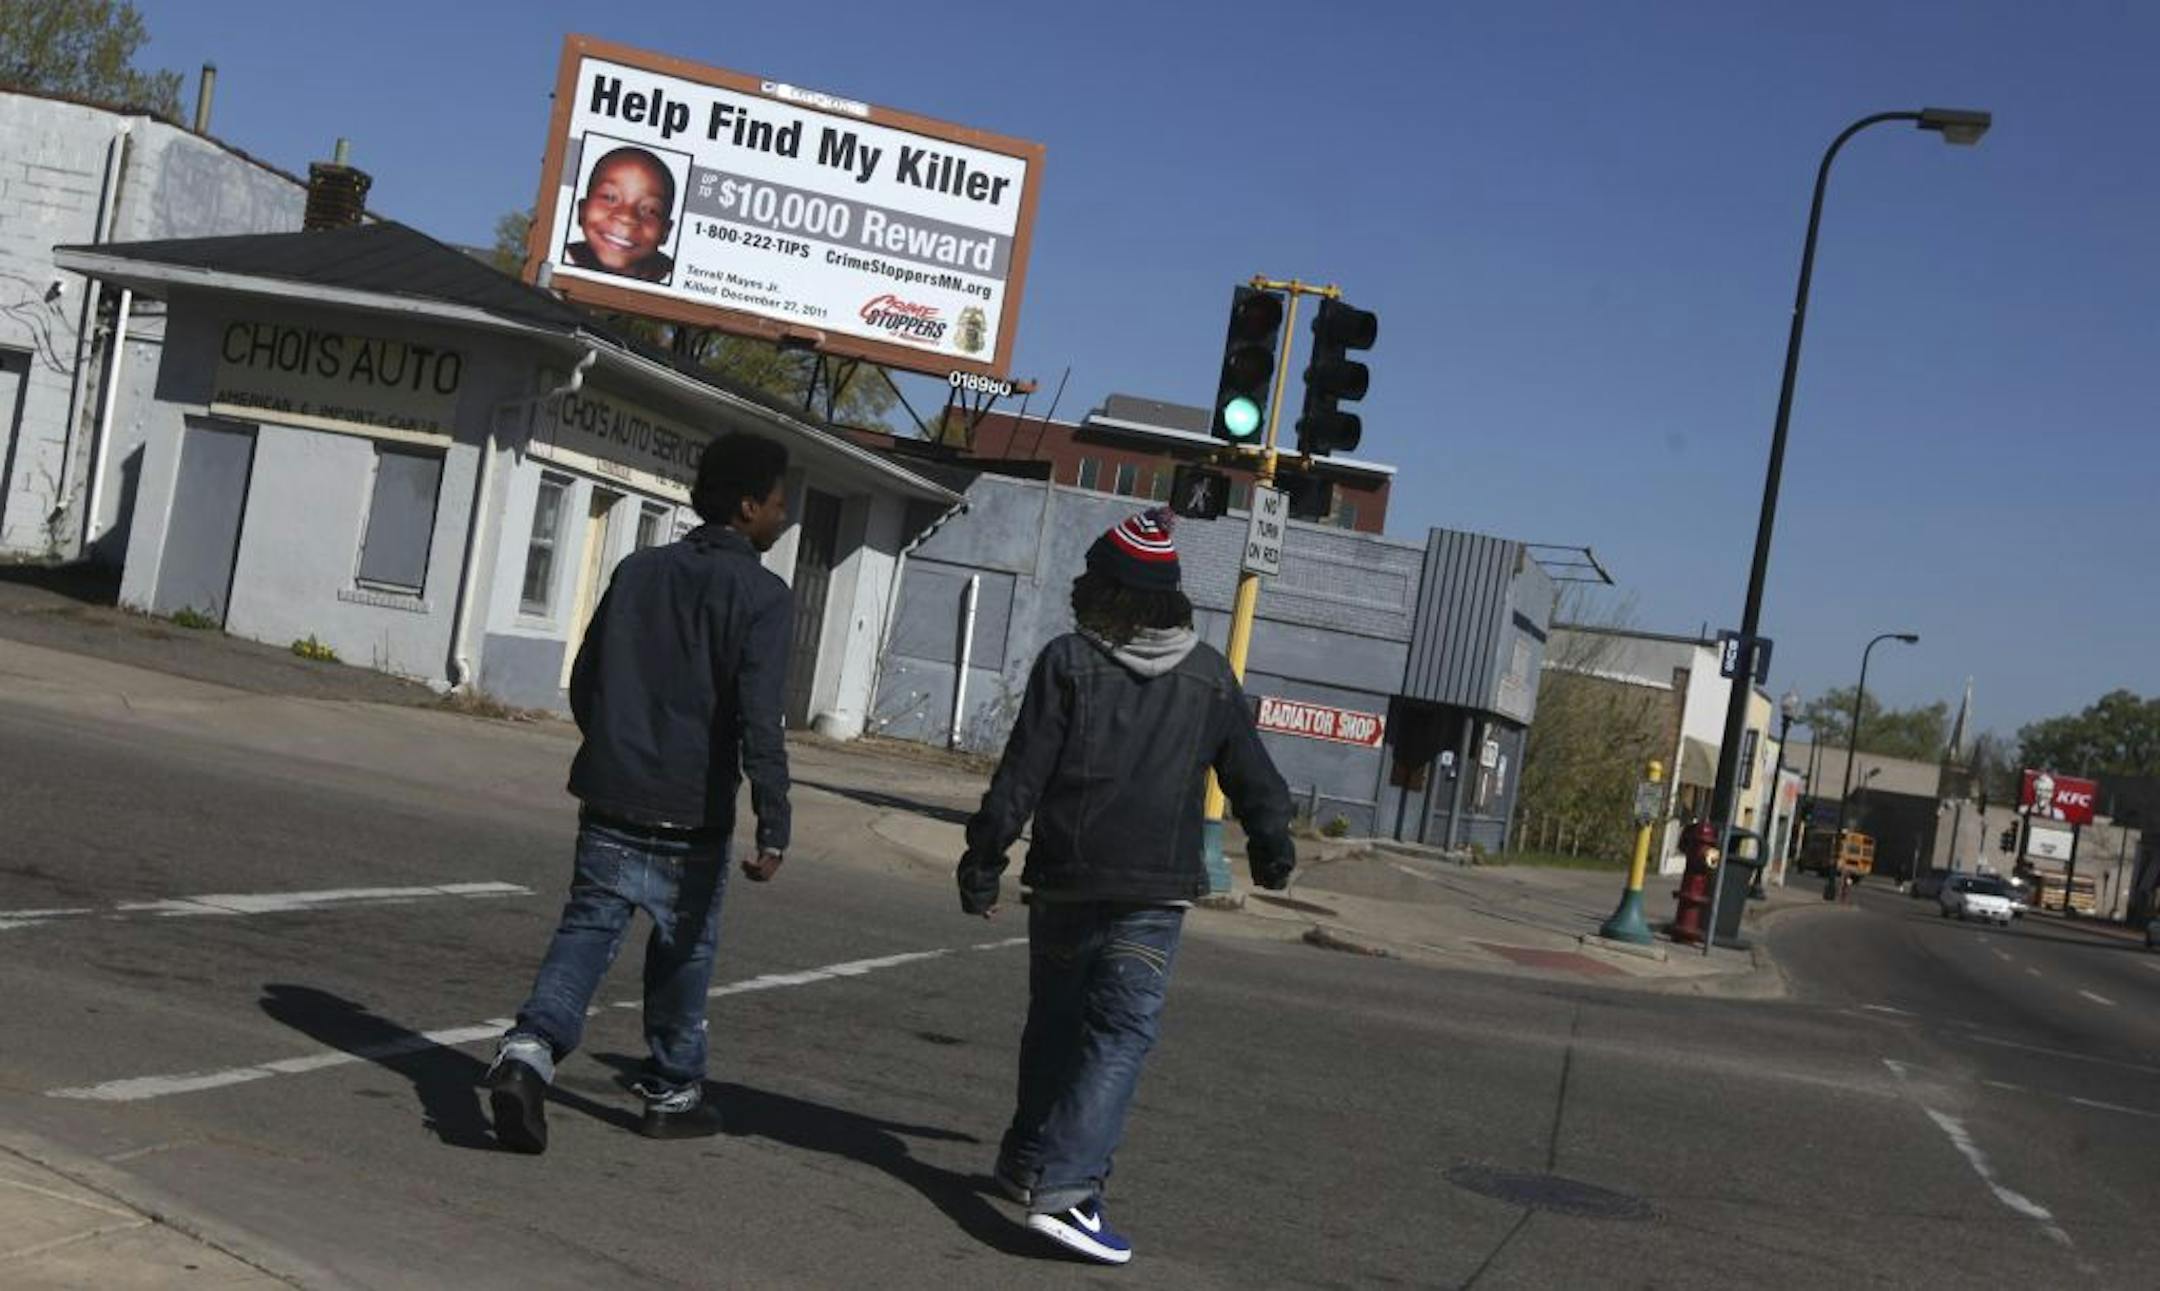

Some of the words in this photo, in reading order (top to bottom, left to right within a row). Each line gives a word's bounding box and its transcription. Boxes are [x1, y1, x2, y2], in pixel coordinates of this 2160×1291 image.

[590, 74, 690, 139] Help
[707, 101, 803, 158] Find
[818, 127, 882, 183] My
[896, 145, 1010, 205] Killer
[701, 173, 718, 185] UP
[718, 179, 851, 239] $10,000
[860, 209, 997, 271] Reward
[686, 263, 724, 281] Terrell
[727, 272, 763, 291] Mayes
[695, 221, 811, 258] 1-800-222-TIPS
[826, 250, 993, 300] CrimeStoppersMN.org
[683, 279, 718, 296] Killed
[721, 286, 782, 307] December
[783, 301, 800, 314] 27,
[803, 305, 829, 318] 2011
[866, 307, 948, 340] STOPPERS
[222, 321, 345, 378] CHOI'S
[349, 338, 463, 395] AUTO
[950, 370, 1012, 397] 018980
[609, 409, 650, 452] AUTO
[1263, 496, 1278, 516] NO
[1248, 541, 1260, 560] ON
[1263, 545, 1279, 564] RED
[1258, 699, 1335, 735] RADIATOR
[1336, 711, 1378, 742] SHOP
[2056, 790, 2092, 808] KFC
